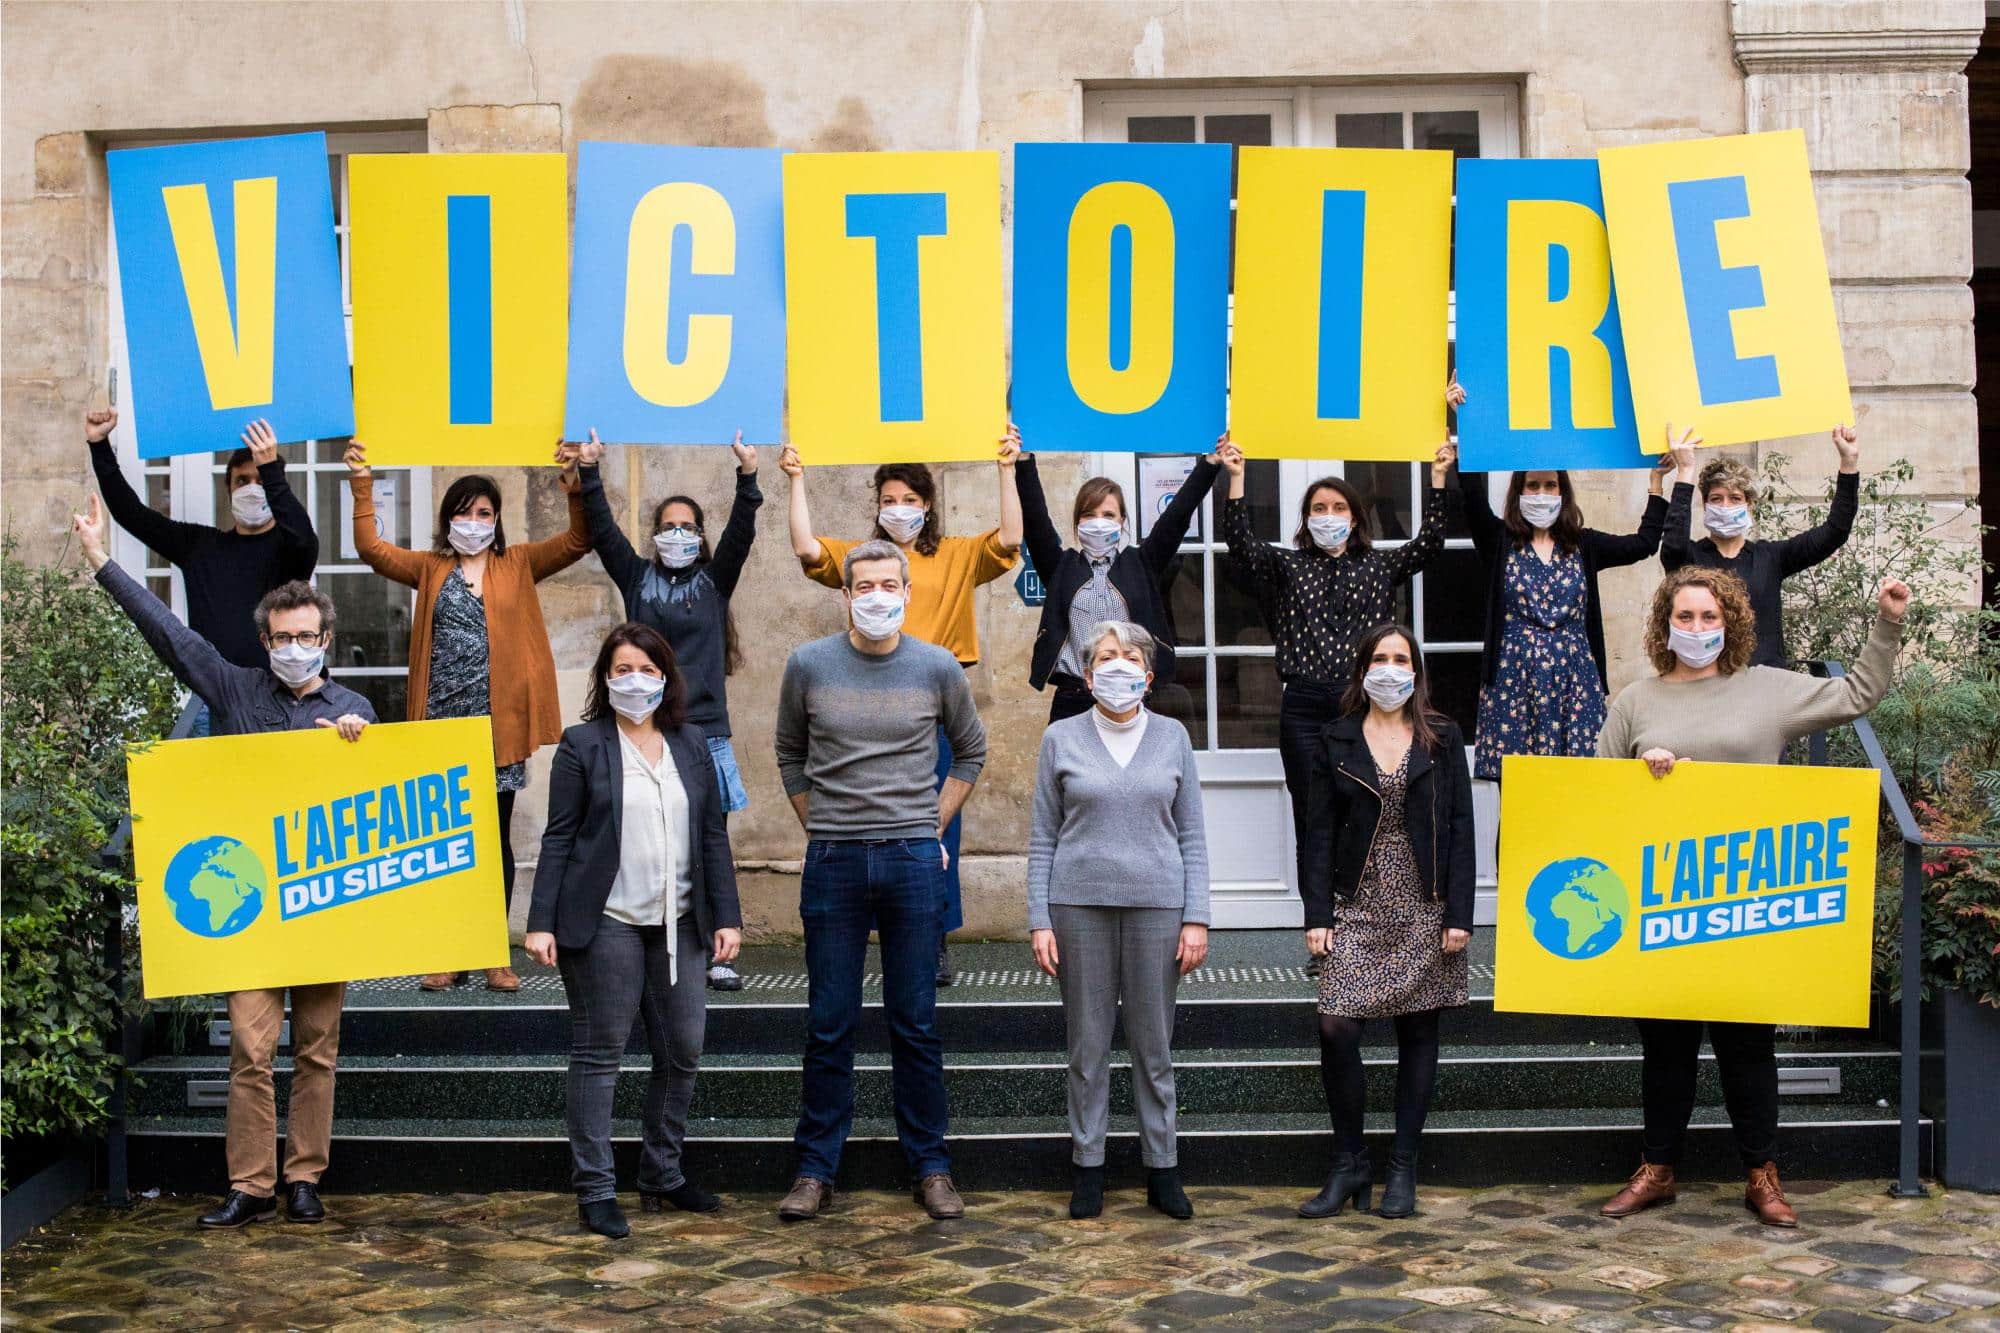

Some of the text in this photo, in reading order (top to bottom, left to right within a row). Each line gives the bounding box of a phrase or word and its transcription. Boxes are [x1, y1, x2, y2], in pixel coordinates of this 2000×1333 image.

[162, 175, 1781, 430] VICTOIRE
[273, 764, 472, 878] L'AFFAIRE
[1640, 816, 1850, 907] L'AFFAIRE
[284, 838, 470, 915] DU SIÈCLE
[1645, 891, 1841, 945] DU SIÈCLE
